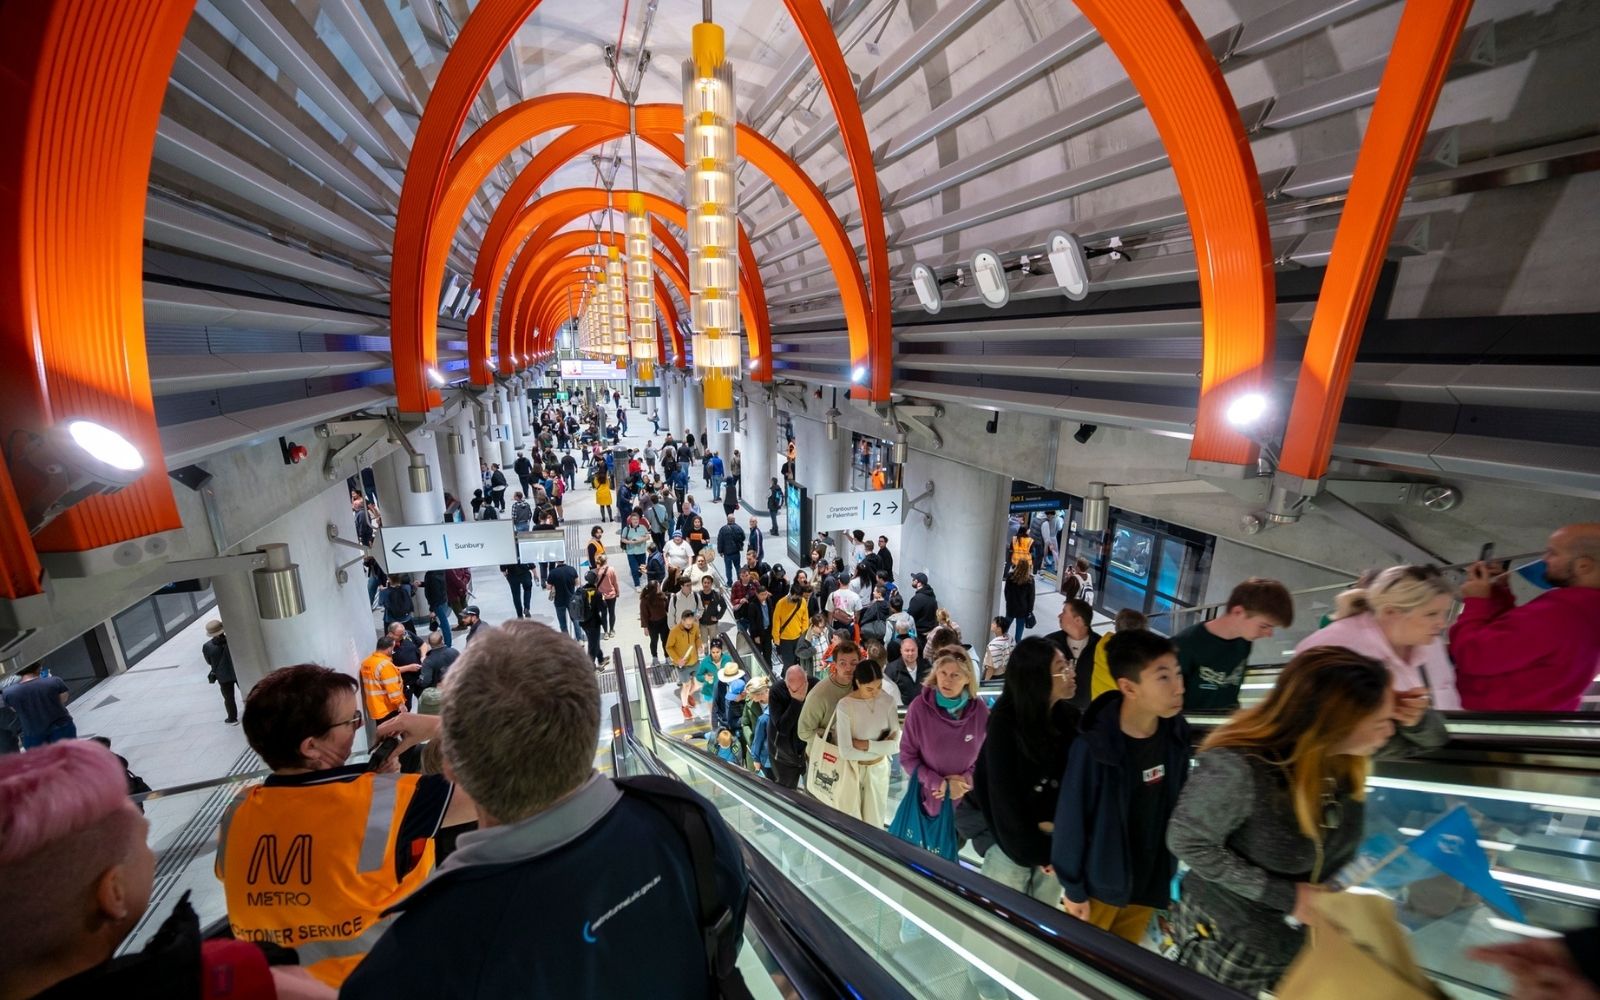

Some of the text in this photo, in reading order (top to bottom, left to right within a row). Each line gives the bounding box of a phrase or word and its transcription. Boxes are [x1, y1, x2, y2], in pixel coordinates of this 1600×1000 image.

[721, 420, 729, 431] 2
[494, 427, 502, 439] 1
[829, 505, 858, 513] Cranbourne
[832, 511, 858, 519] Pakenham
[872, 502, 881, 516] 2
[418, 540, 432, 557] 1
[454, 540, 485, 550] Sunbury
[247, 891, 311, 906] METRO
[298, 916, 362, 940] SERVICE
